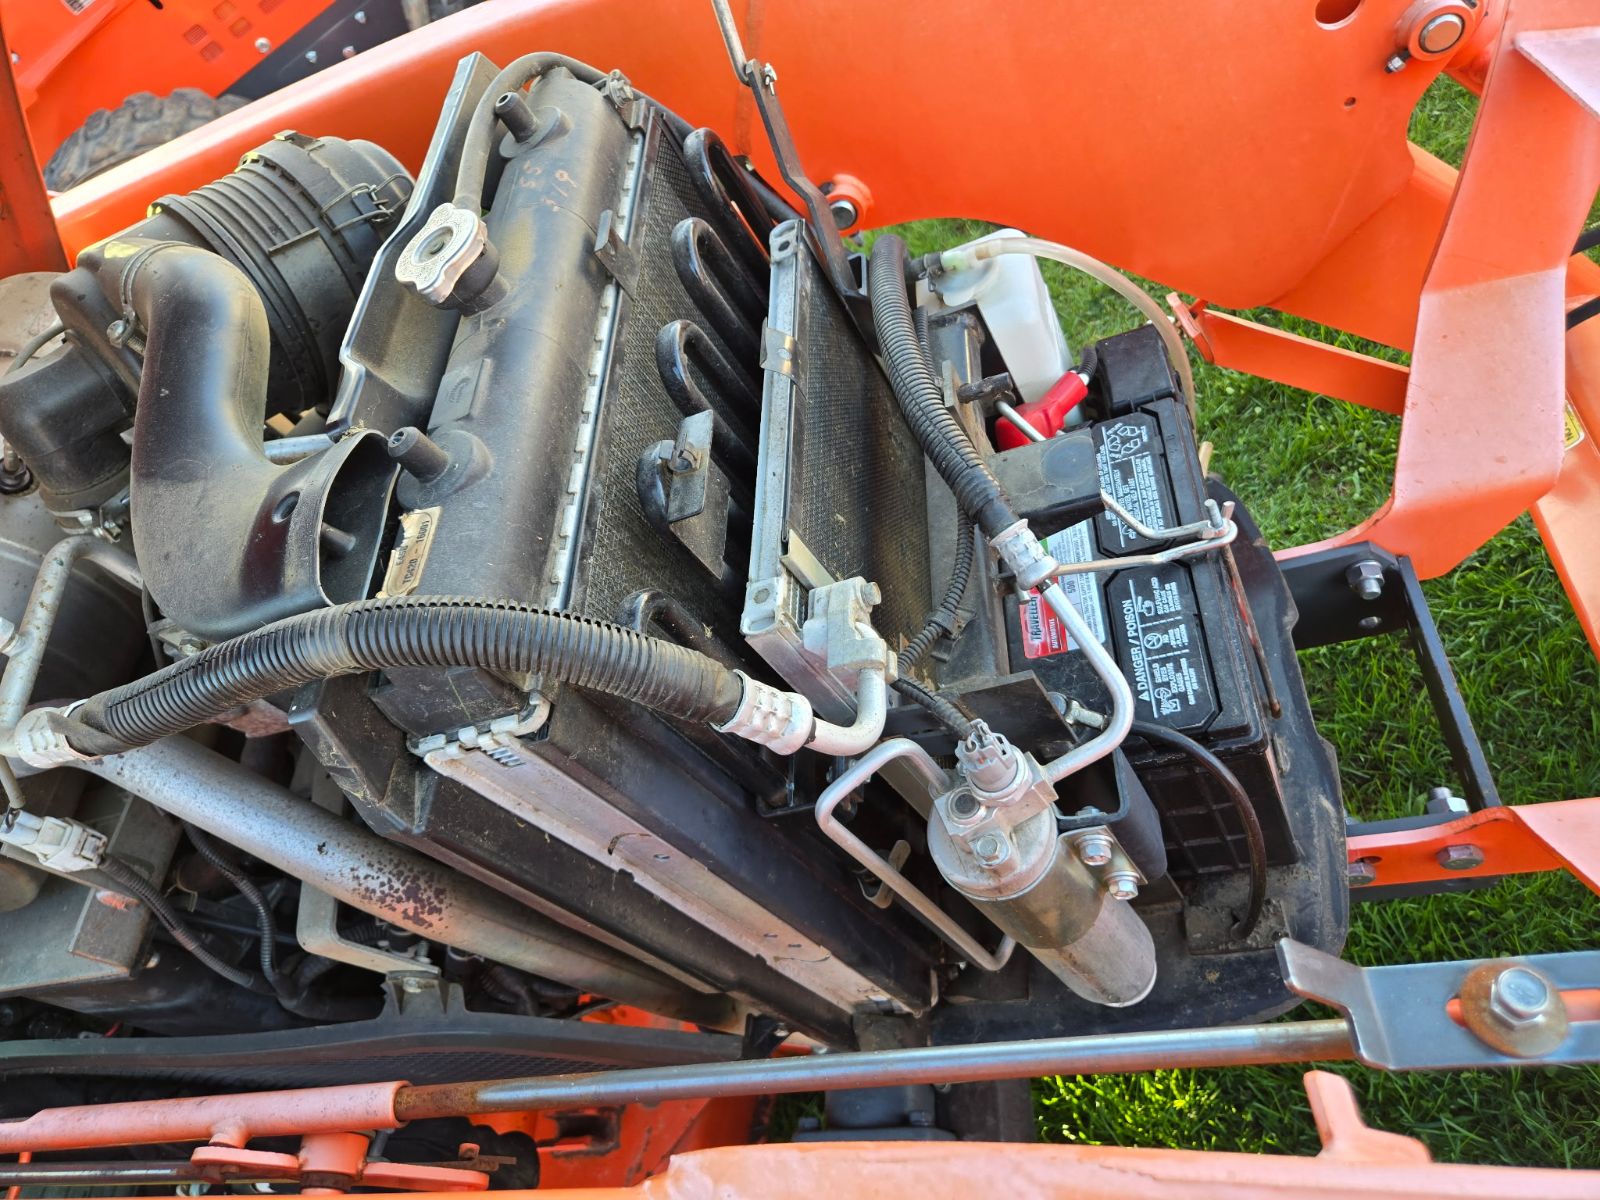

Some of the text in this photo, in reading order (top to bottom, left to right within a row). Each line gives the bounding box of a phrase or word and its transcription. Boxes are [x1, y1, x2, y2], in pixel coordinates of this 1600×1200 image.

[1067, 579, 1076, 593] 500
[1048, 618, 1059, 649] AUTOMOTIVE
[1122, 599, 1137, 637] POISON
[1131, 647, 1146, 690] DANGER
